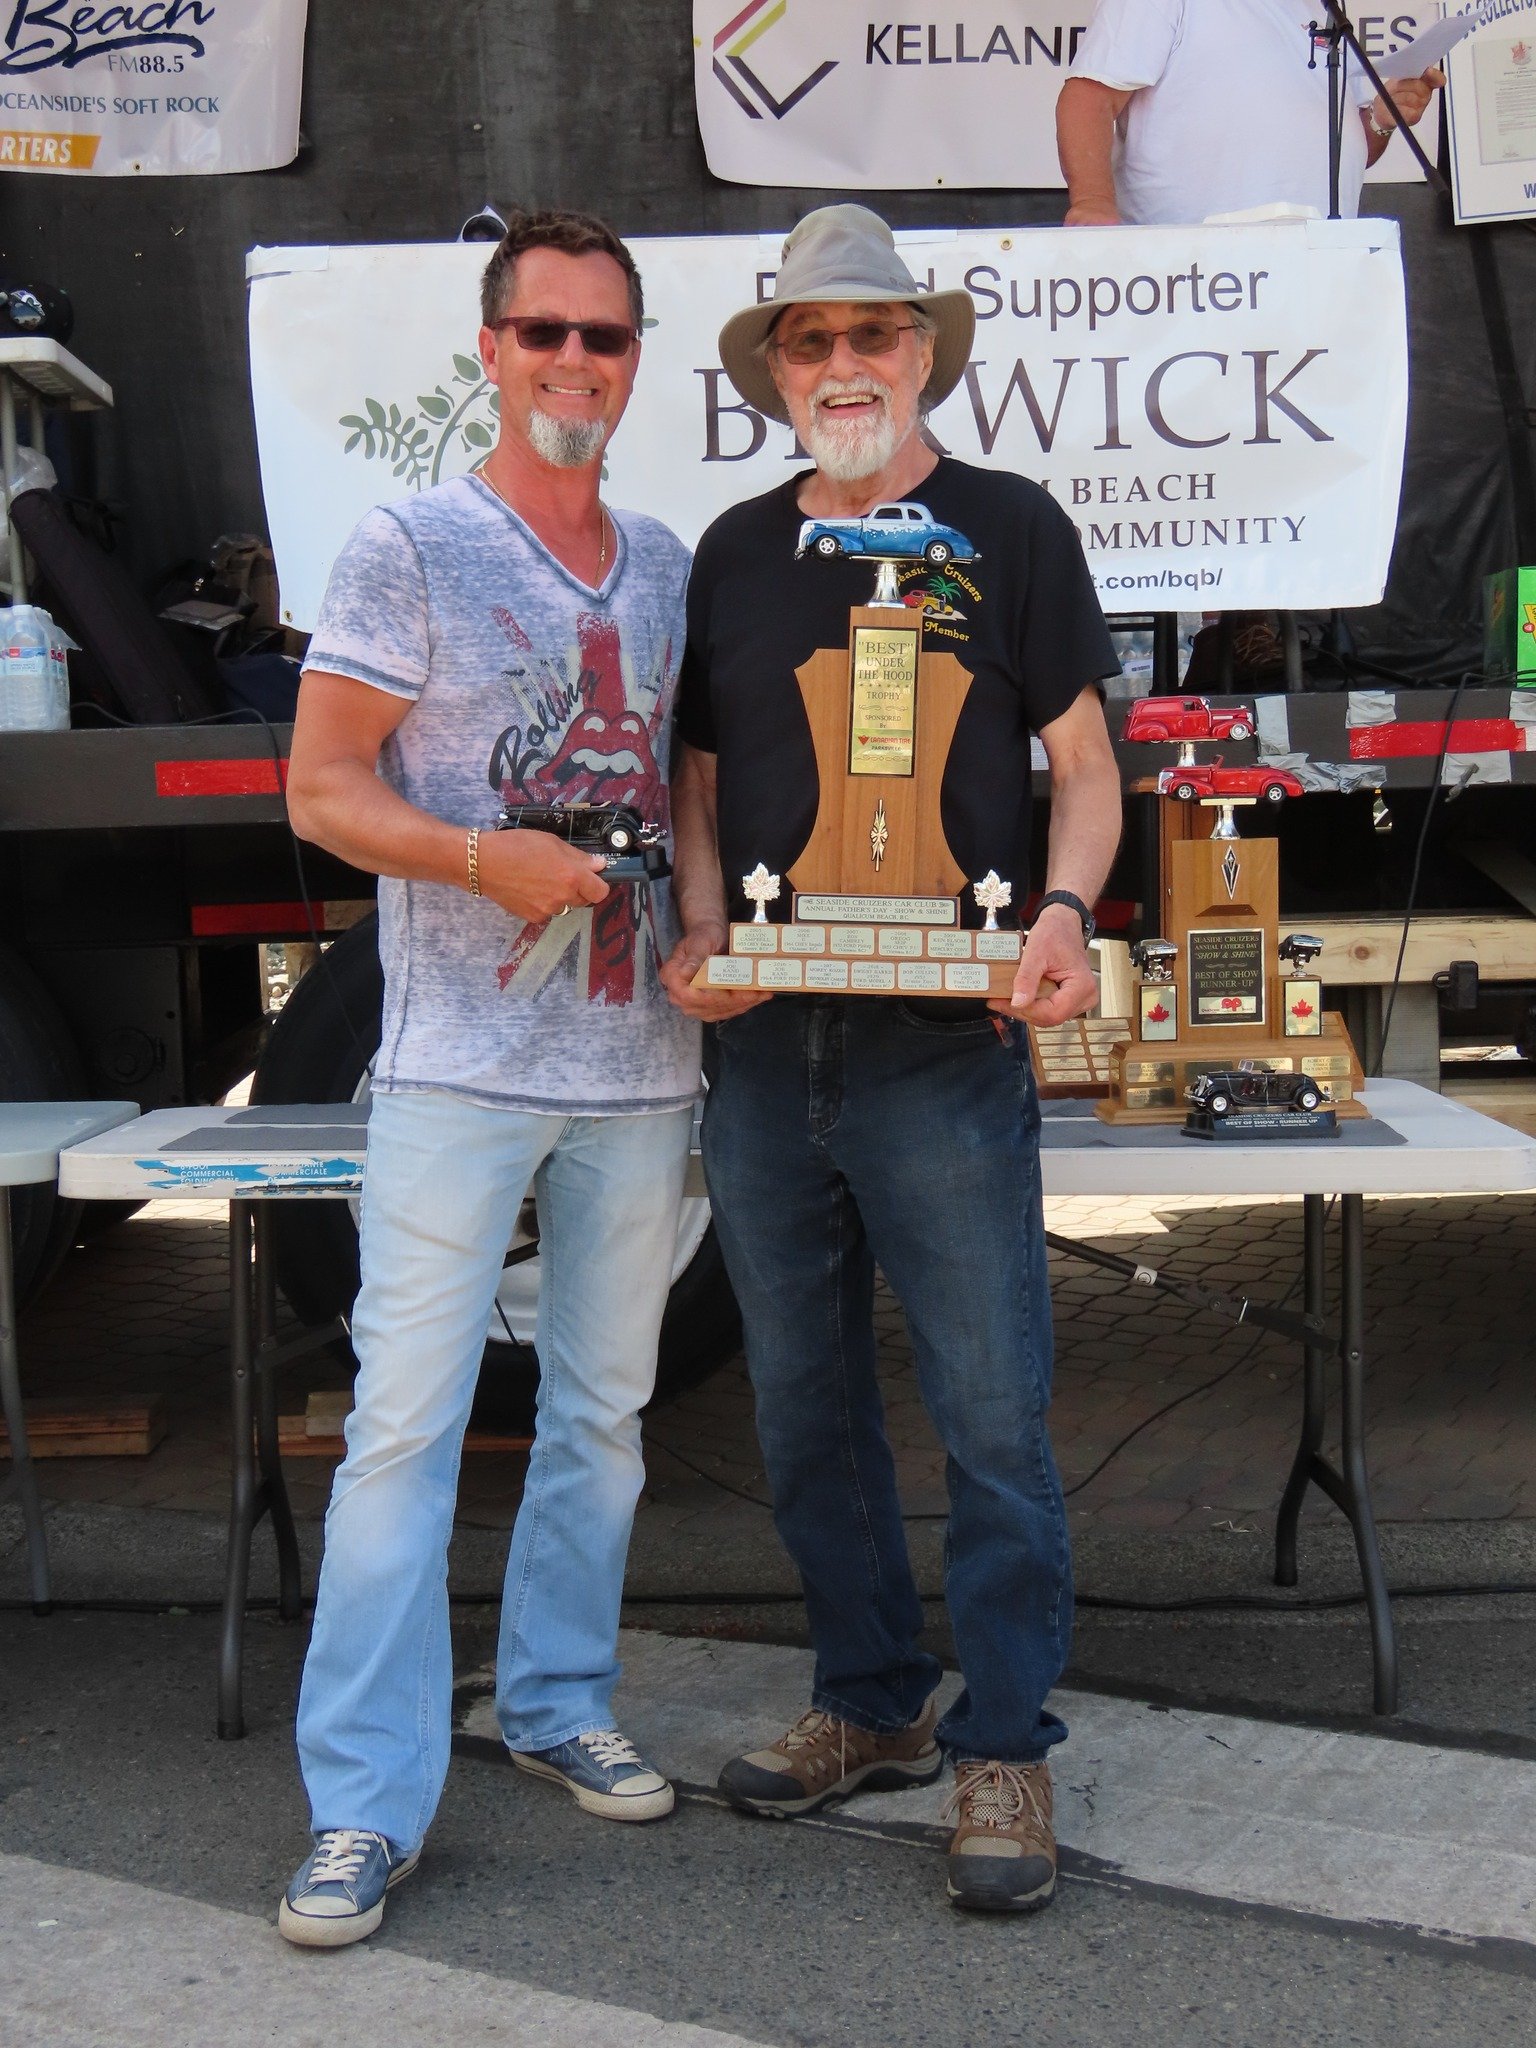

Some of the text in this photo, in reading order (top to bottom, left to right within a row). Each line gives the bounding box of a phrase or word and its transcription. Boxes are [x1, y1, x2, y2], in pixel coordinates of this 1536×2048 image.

[0, 0, 214, 70] Beach
[113, 97, 159, 115] SOFT
[166, 96, 220, 113] ROCK
[963, 265, 1269, 331] Supporter
[693, 348, 1334, 463] BWICK
[1070, 473, 1217, 504] BEACH
[1076, 516, 1307, 550] MMUNITY
[923, 621, 970, 642] Member
[866, 657, 905, 668] UNDER
[857, 669, 913, 681] THE HOOD
[866, 691, 902, 700] TROPHY
[864, 714, 902, 722] SPONSORED
[852, 899, 893, 907] CRUIZERS
[1224, 935, 1260, 943] CRUIZERS
[1222, 950, 1229, 959] &
[1195, 970, 1259, 980] BEST OF SHOW
